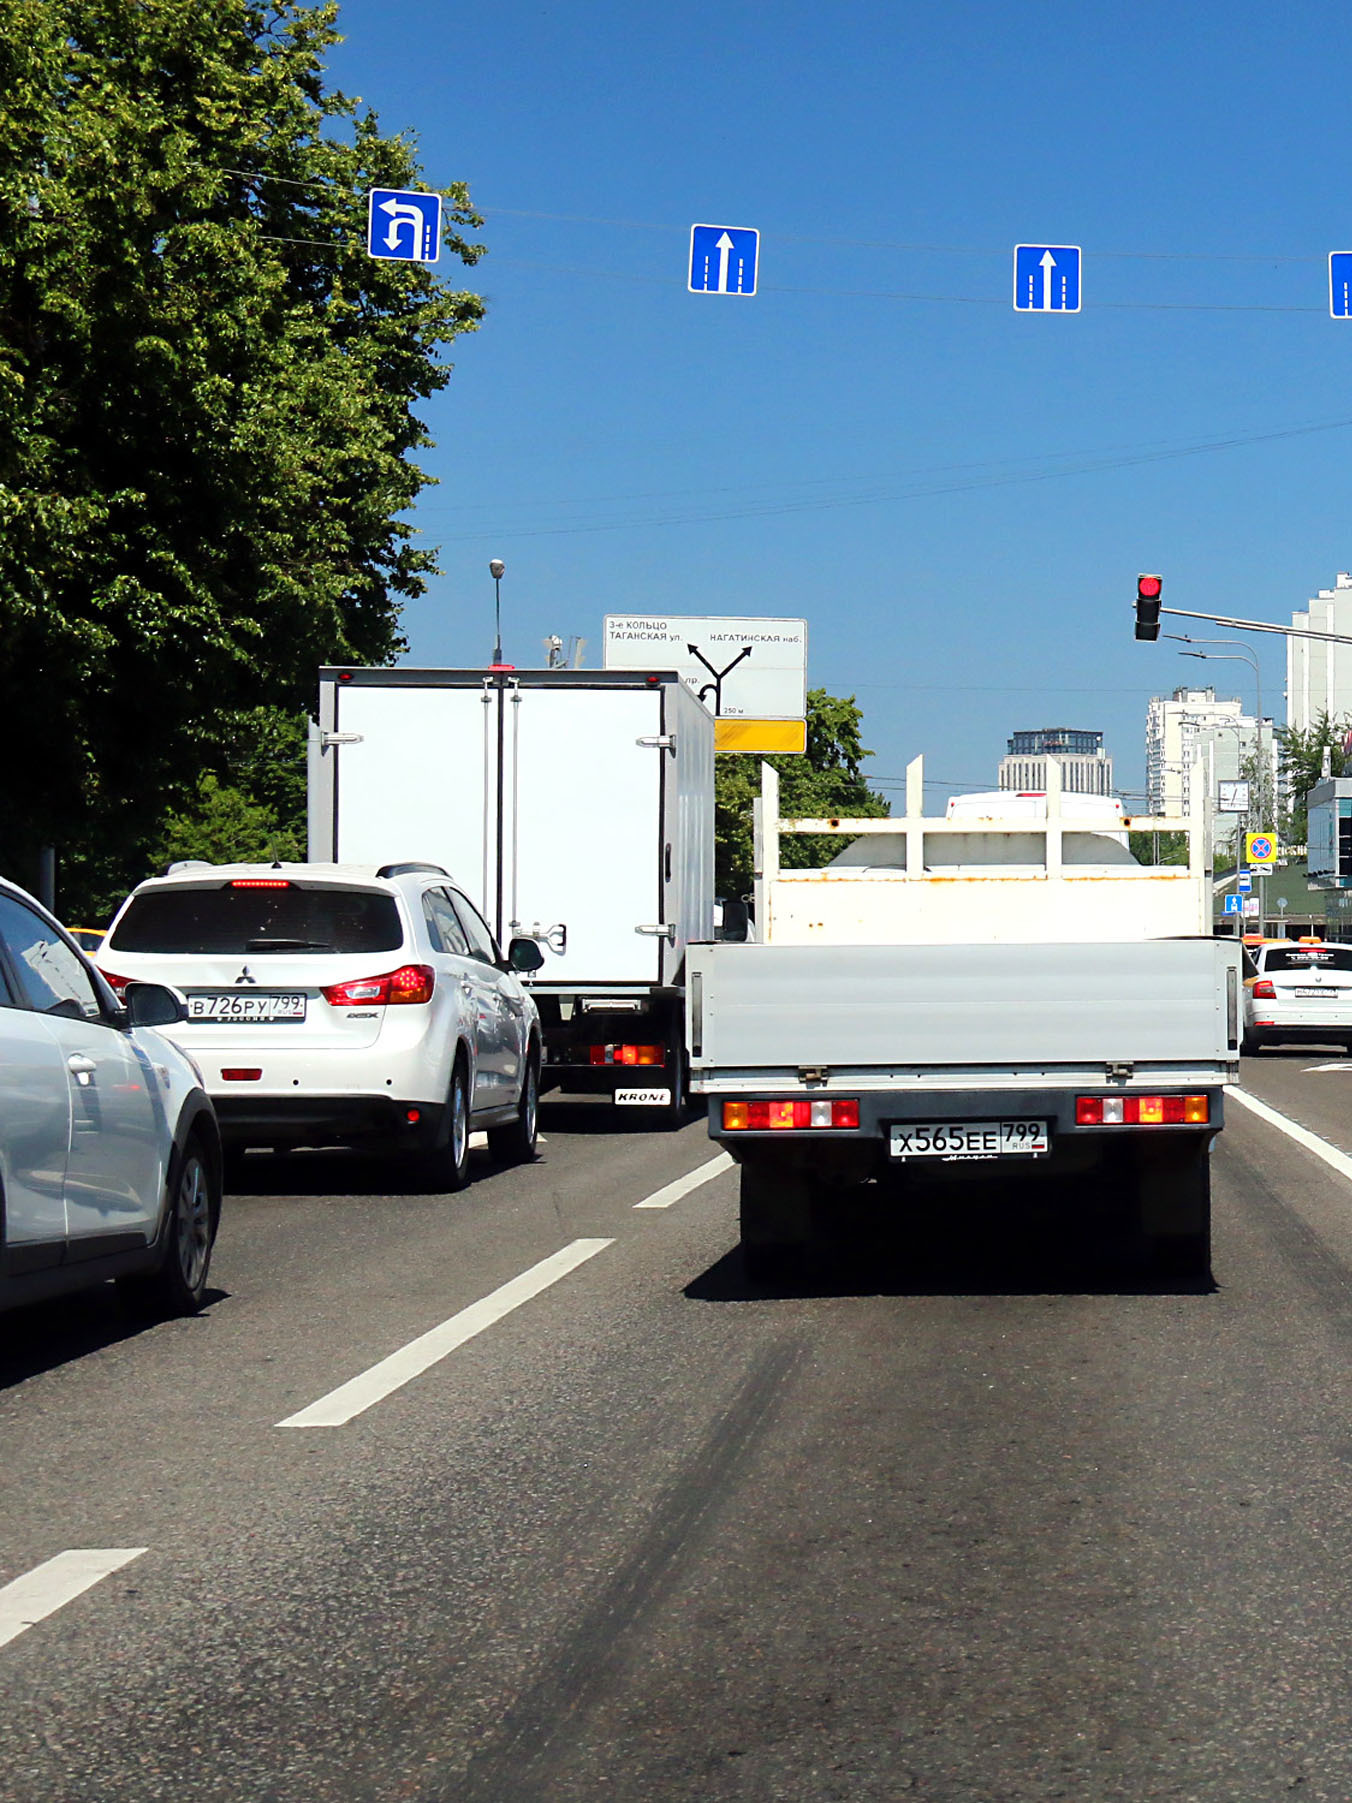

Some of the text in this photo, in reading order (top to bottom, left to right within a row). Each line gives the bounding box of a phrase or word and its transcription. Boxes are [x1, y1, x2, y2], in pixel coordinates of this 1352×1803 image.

[626, 621, 667, 630] КОЛЬЦО
[609, 631, 667, 640] ТАГАНСКАЯ
[710, 634, 802, 643] НАГАТИНСКАЯ наб.
[272, 995, 300, 1009] 799
[618, 1093, 666, 1101] KRONE
[1003, 1123, 1040, 1142] 799
[1012, 1142, 1031, 1150] RUS
